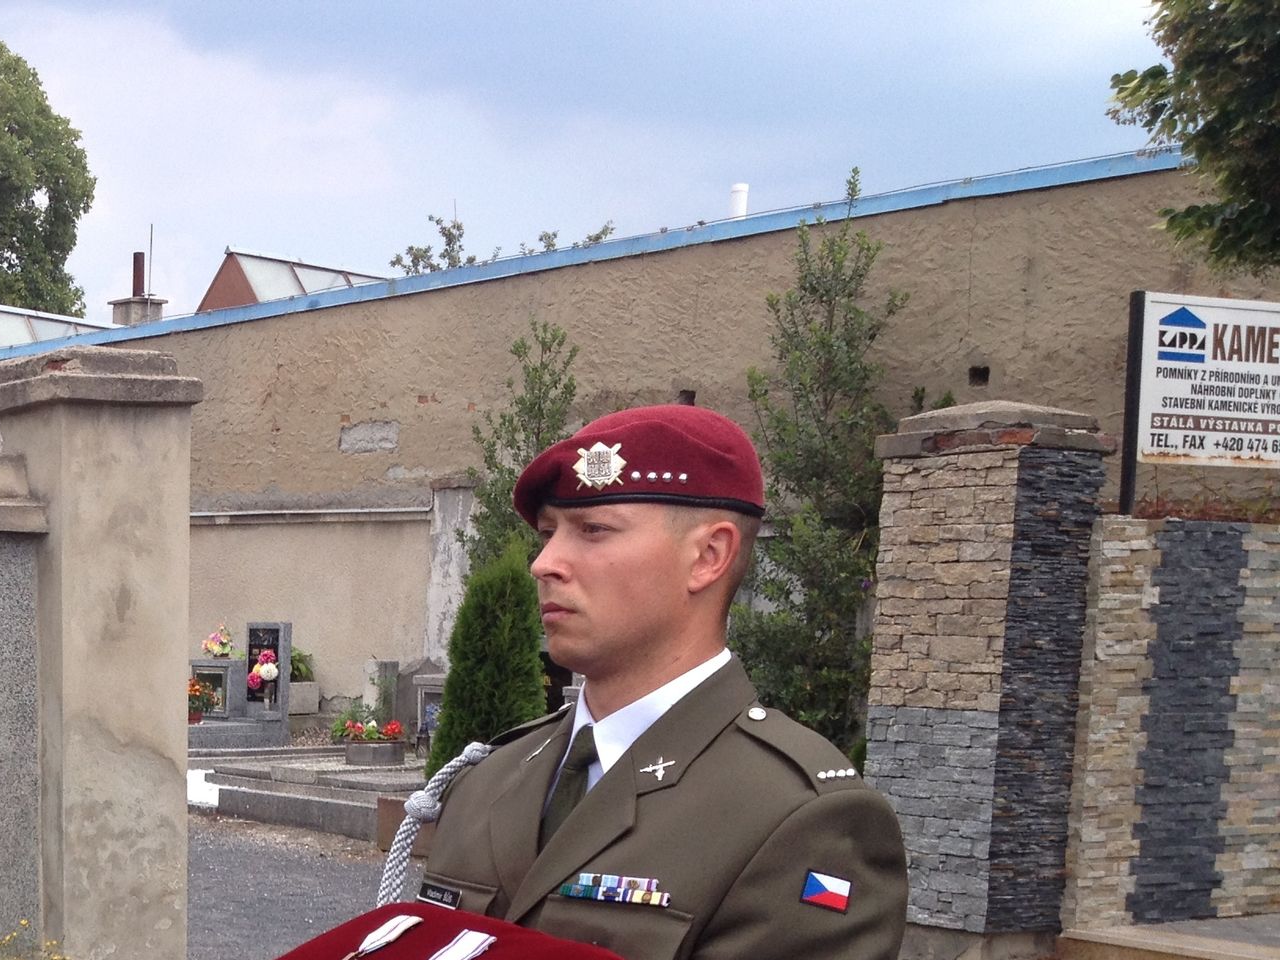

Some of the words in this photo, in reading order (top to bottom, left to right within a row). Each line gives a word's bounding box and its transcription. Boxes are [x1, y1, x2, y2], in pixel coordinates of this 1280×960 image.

[1158, 330, 1206, 351] KAPPA
[1212, 323, 1280, 364] KAME
[1156, 367, 1198, 381] POMNÍKY
[1200, 370, 1207, 381] Z
[1209, 368, 1260, 385] PŘÍRODNÍHO
[1263, 374, 1269, 385] A
[1190, 384, 1236, 398] NÁHROBNÍ
[1238, 386, 1277, 401] DOPLŇKY
[1161, 396, 1206, 410] STAVEBNÍ
[1208, 399, 1258, 413] KAMENICKÉ
[1153, 416, 1194, 428] STÁLÁ
[1200, 418, 1263, 432] VÝSTAVKA
[1150, 433, 1178, 450] TEL.,
[1182, 435, 1206, 449] FAX
[1213, 437, 1243, 452] +420
[1247, 438, 1268, 453] 474
